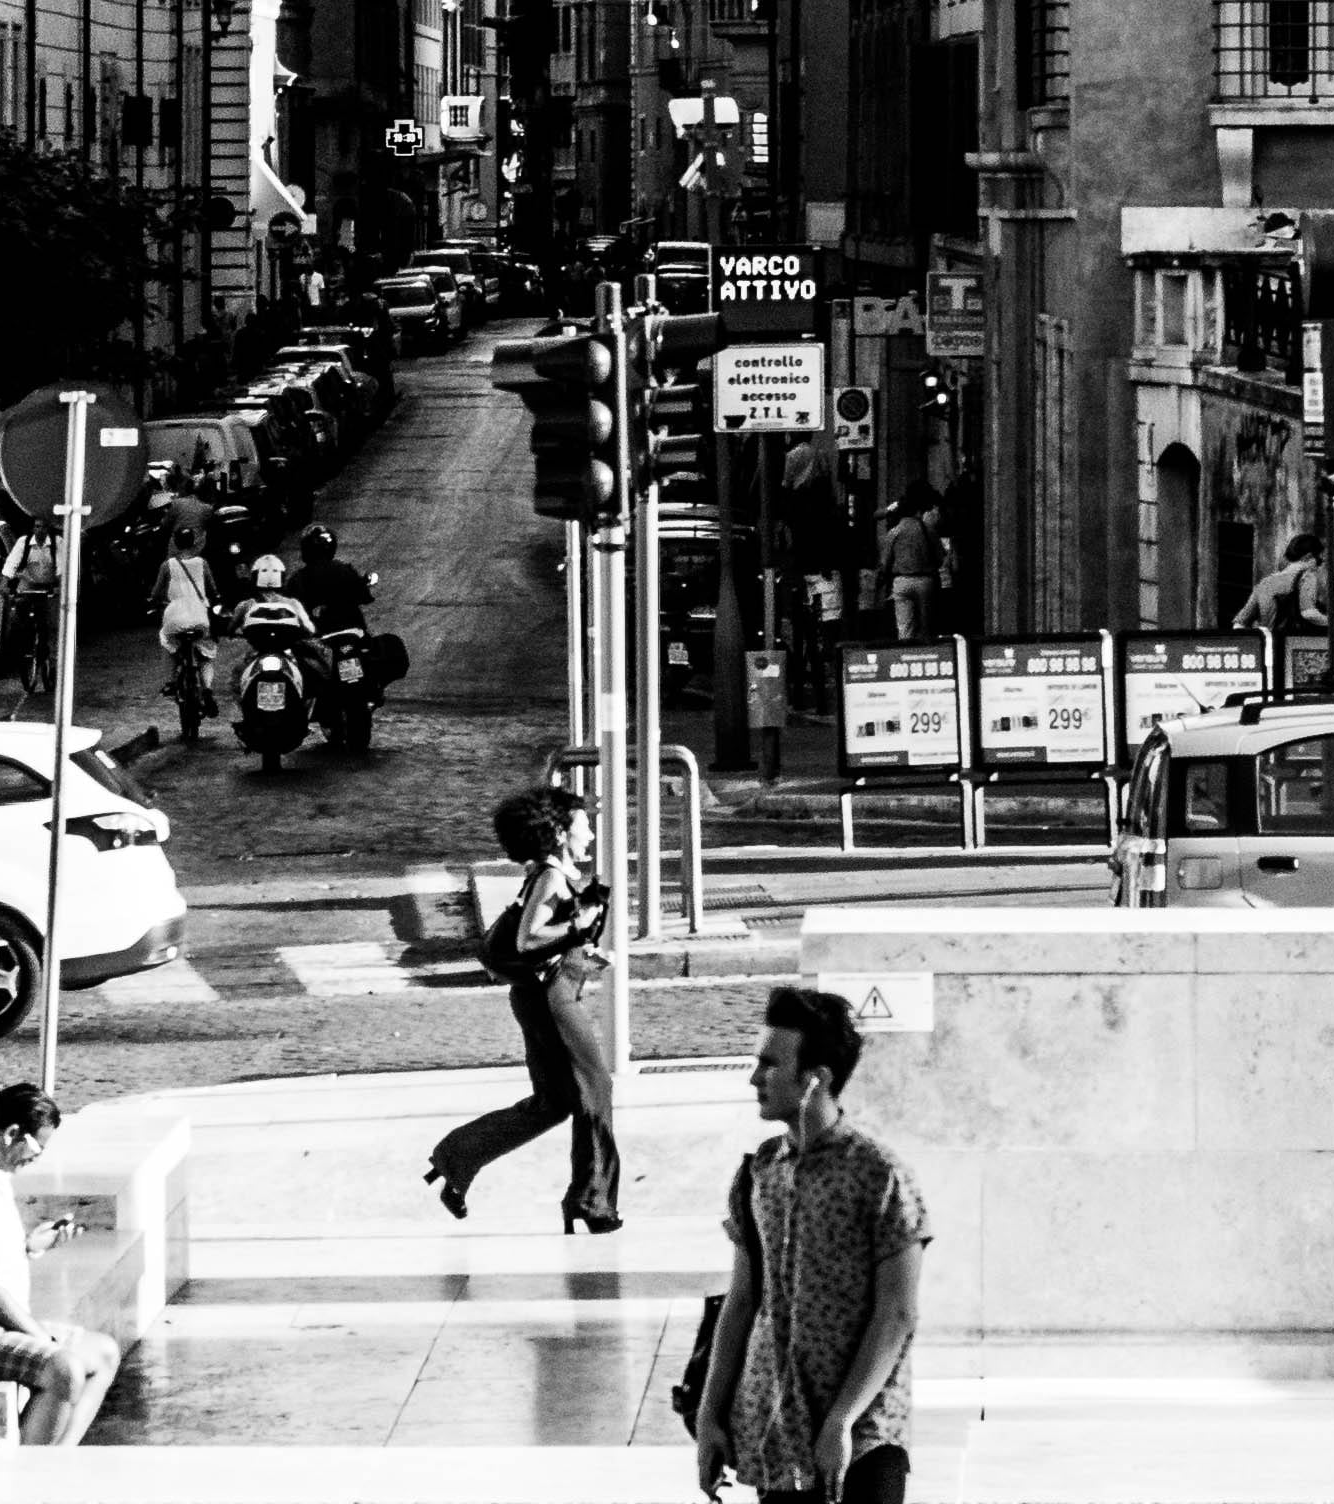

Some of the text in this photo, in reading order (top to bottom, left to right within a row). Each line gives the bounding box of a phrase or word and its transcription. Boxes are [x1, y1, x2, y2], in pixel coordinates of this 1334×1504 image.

[719, 255, 800, 276] VARCO
[720, 279, 816, 301] ATTIVO
[938, 278, 977, 310] T
[734, 355, 803, 368] controllo
[728, 372, 810, 385] elettronico
[741, 391, 797, 402] accesso
